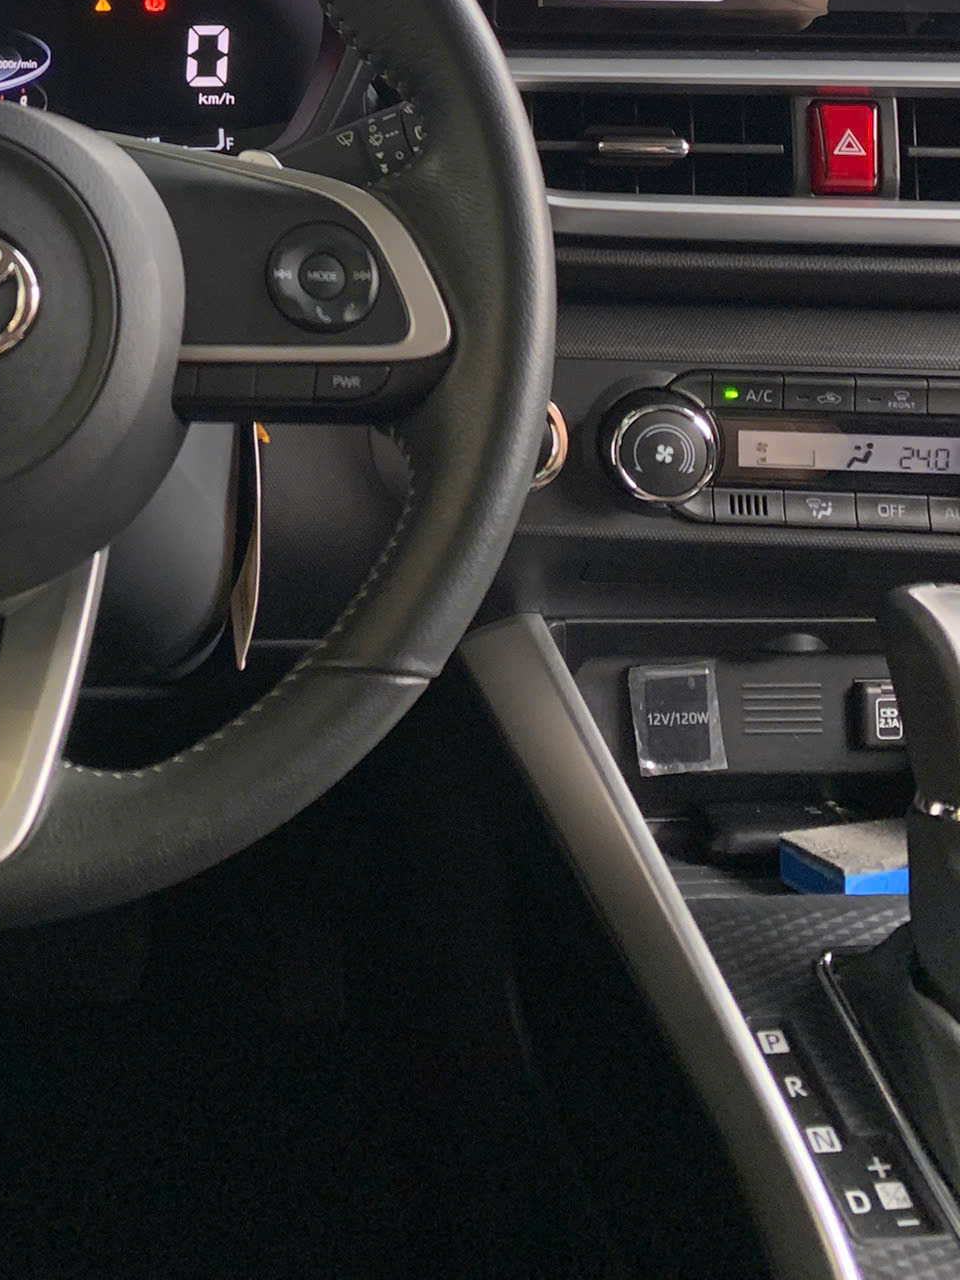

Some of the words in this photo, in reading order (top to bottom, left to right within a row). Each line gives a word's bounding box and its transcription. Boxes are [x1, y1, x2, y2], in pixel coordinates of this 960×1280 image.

[185, 24, 230, 88] 0
[197, 91, 236, 106] km/h
[225, 136, 235, 151] F
[306, 270, 338, 283] MODE
[332, 374, 361, 389] PWR
[745, 388, 774, 403] A/C
[888, 400, 916, 410] FRONT
[878, 503, 906, 519] OFF
[647, 710, 709, 727] 12V/120W
[878, 717, 901, 729] 2.1A
[784, 1075, 808, 1098] R
[844, 1188, 872, 1215] D
